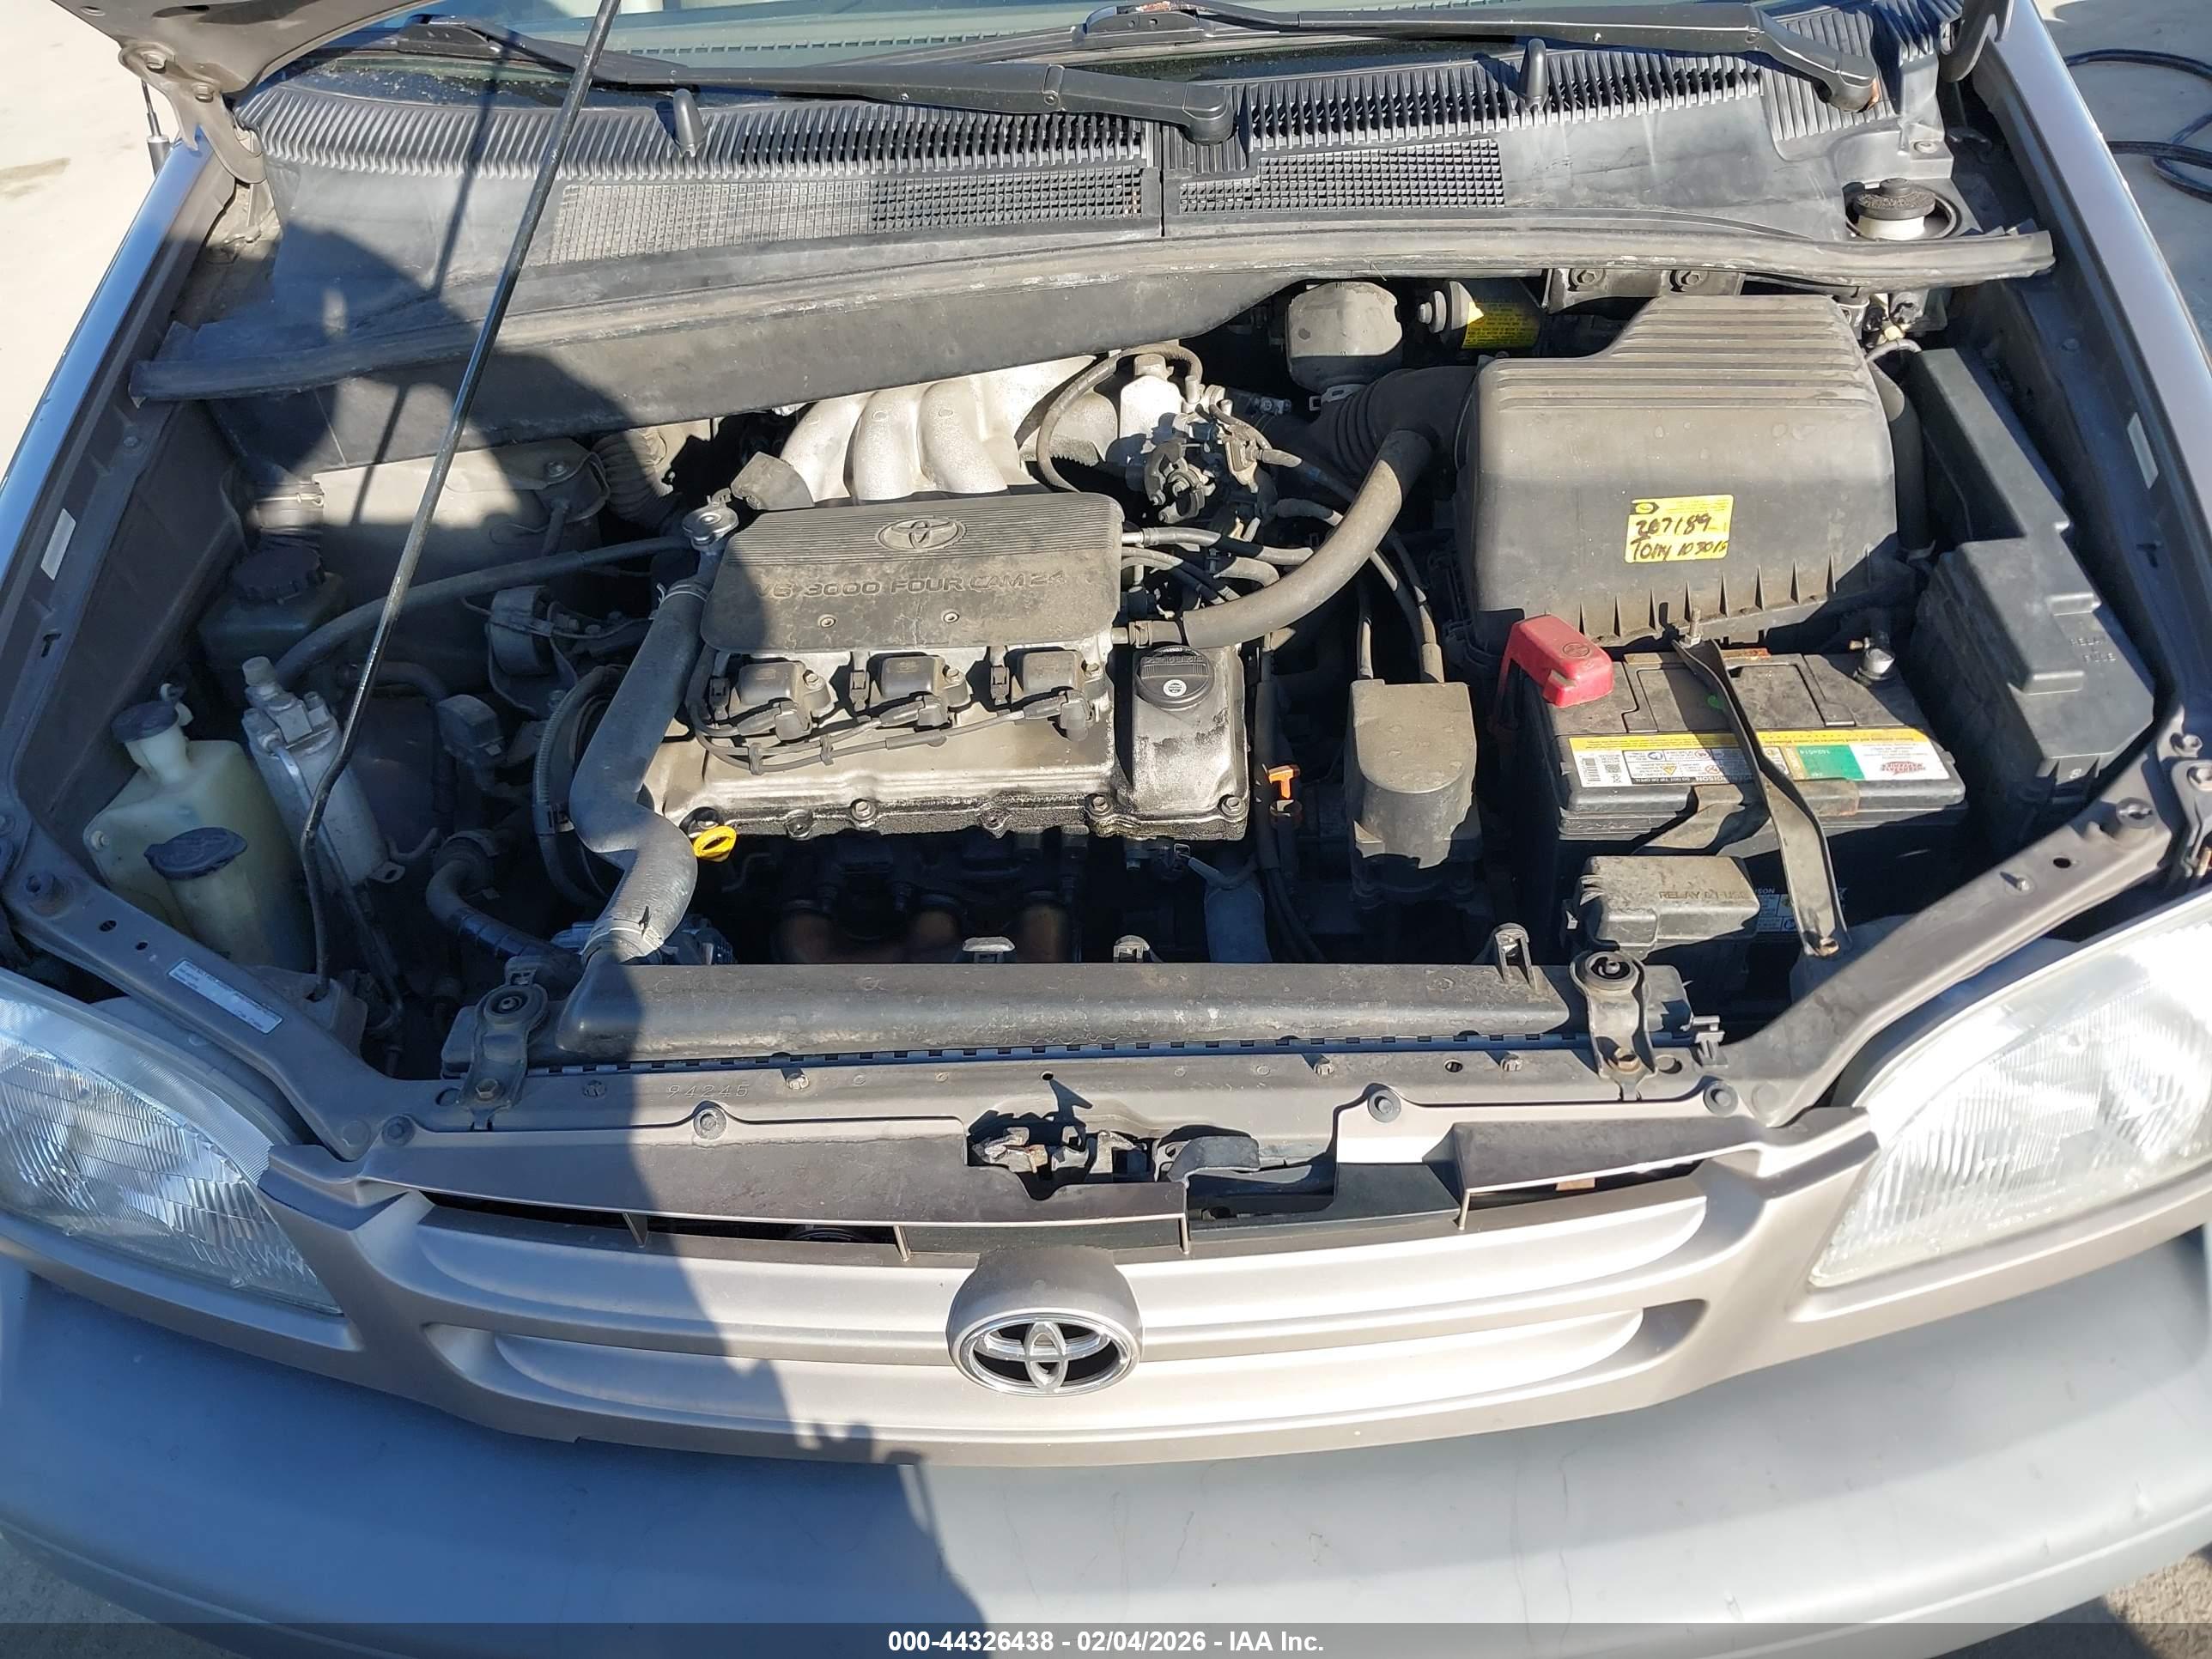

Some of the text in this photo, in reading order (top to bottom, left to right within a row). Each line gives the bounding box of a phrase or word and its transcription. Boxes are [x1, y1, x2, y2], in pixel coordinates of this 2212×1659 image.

[805, 580, 882, 598] 3000
[890, 576, 963, 594] FOUR
[969, 573, 1026, 591] CAM
[1030, 570, 1066, 587] 24
[1658, 890, 1700, 900] RELAY
[665, 1083, 750, 1099] 94245
